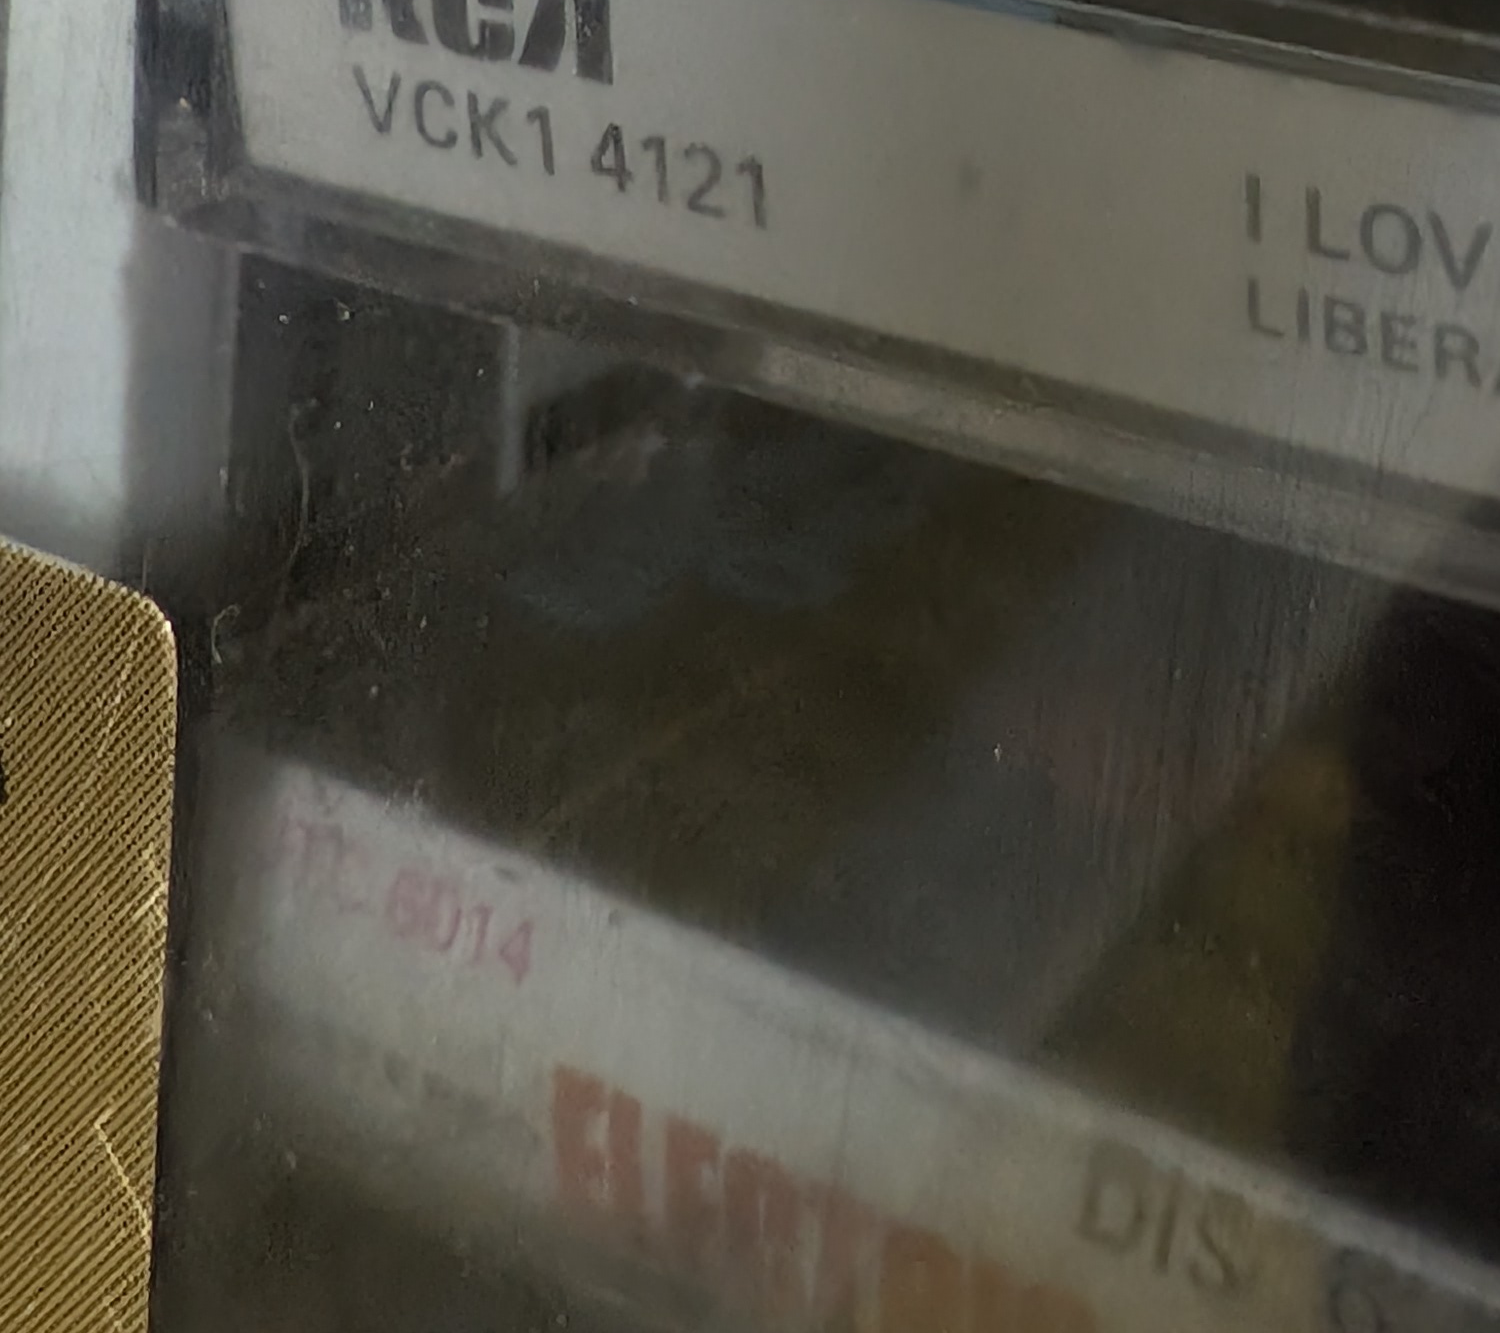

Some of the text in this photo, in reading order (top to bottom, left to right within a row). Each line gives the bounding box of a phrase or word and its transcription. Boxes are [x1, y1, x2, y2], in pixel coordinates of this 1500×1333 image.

[352, 63, 768, 230] VCK1 4121
[1243, 173, 1264, 246] I
